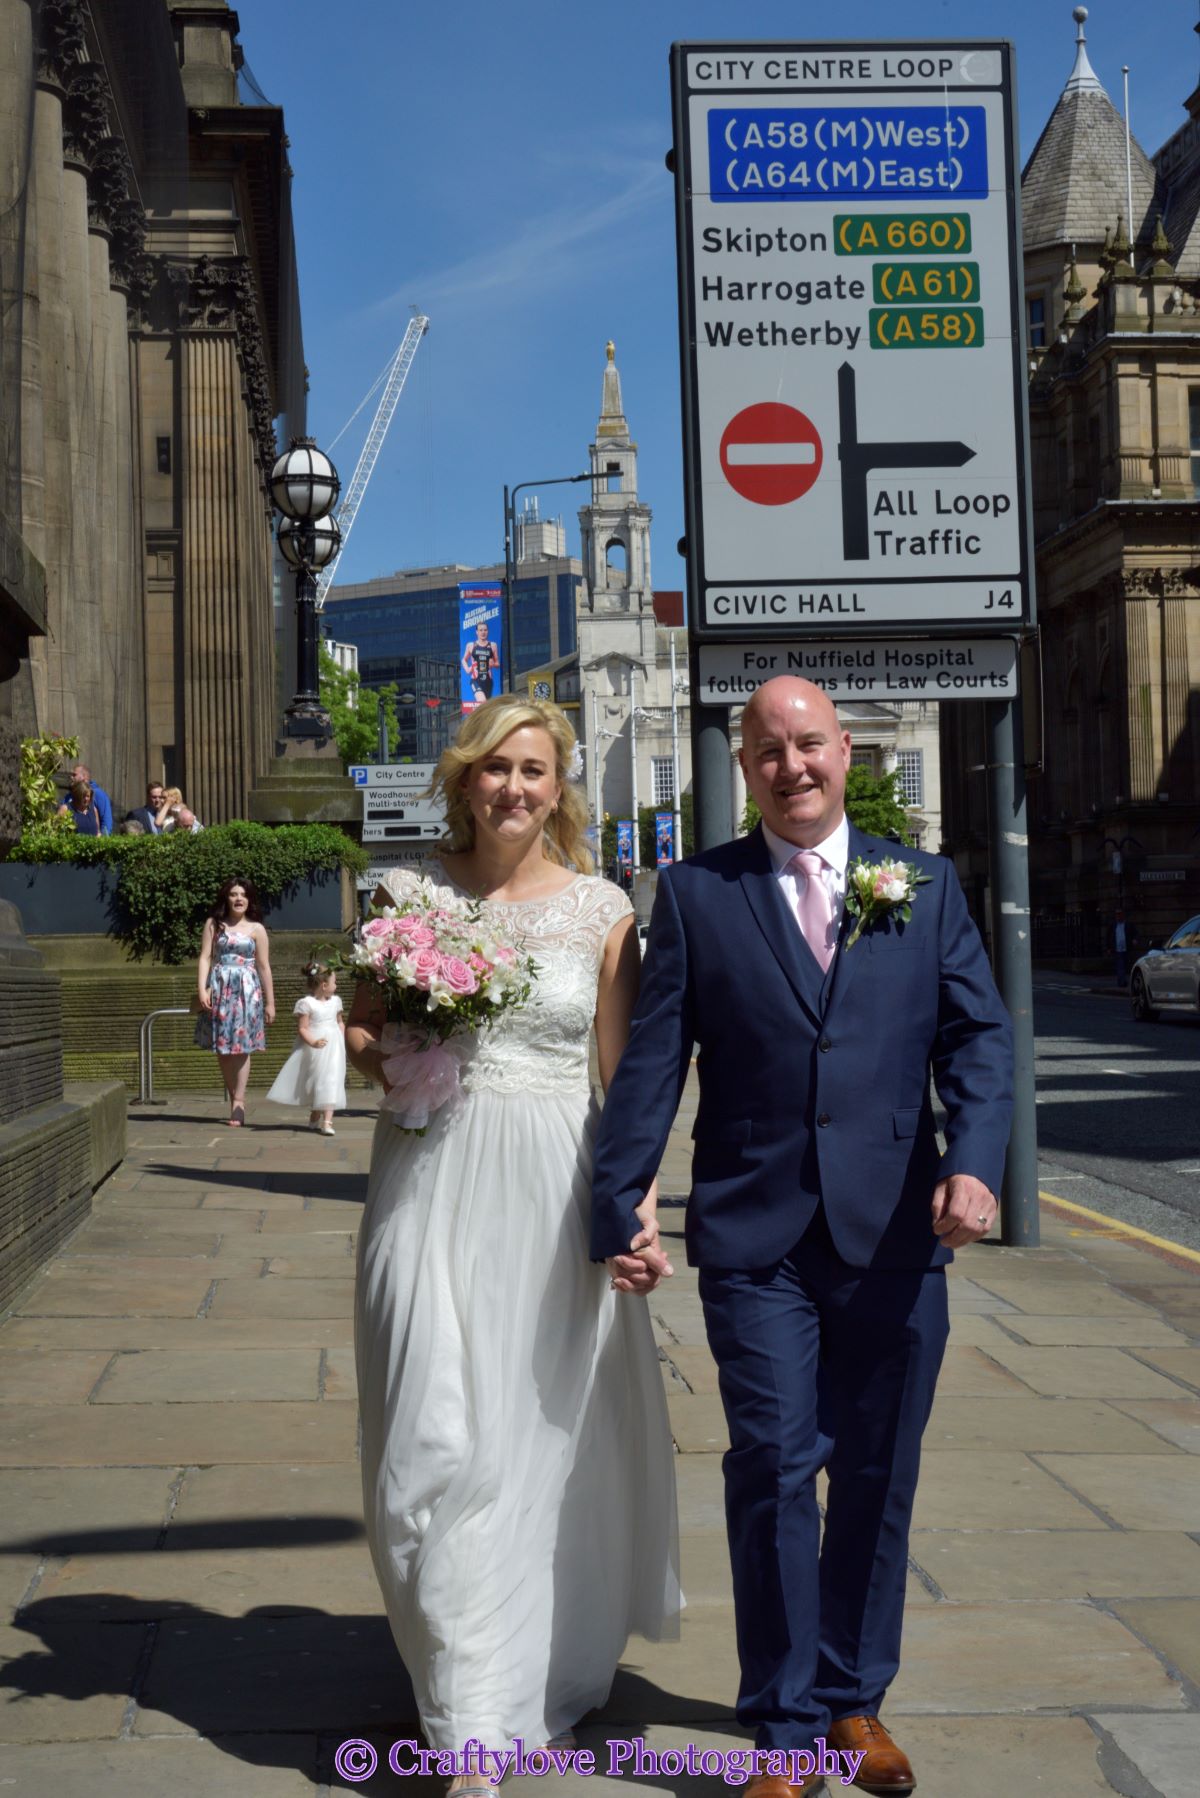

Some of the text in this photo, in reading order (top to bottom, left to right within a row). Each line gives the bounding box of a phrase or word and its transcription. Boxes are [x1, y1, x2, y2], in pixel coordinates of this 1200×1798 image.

[695, 58, 954, 81] CITY CENTRE LOOP
[701, 226, 827, 257] Skipton
[701, 274, 865, 306] Harrogate
[703, 321, 862, 351] Wetherby
[873, 489, 1011, 518] All Loop
[873, 529, 982, 556] Traffic
[713, 592, 866, 615] CIVIC HALL
[984, 589, 1015, 610] J4
[743, 648, 974, 670] For Nuffield Hospital
[846, 674, 876, 690] for
[886, 672, 928, 690] Law
[936, 671, 1009, 688] Courts
[375, 771, 393, 780] City
[396, 770, 425, 779] Centre
